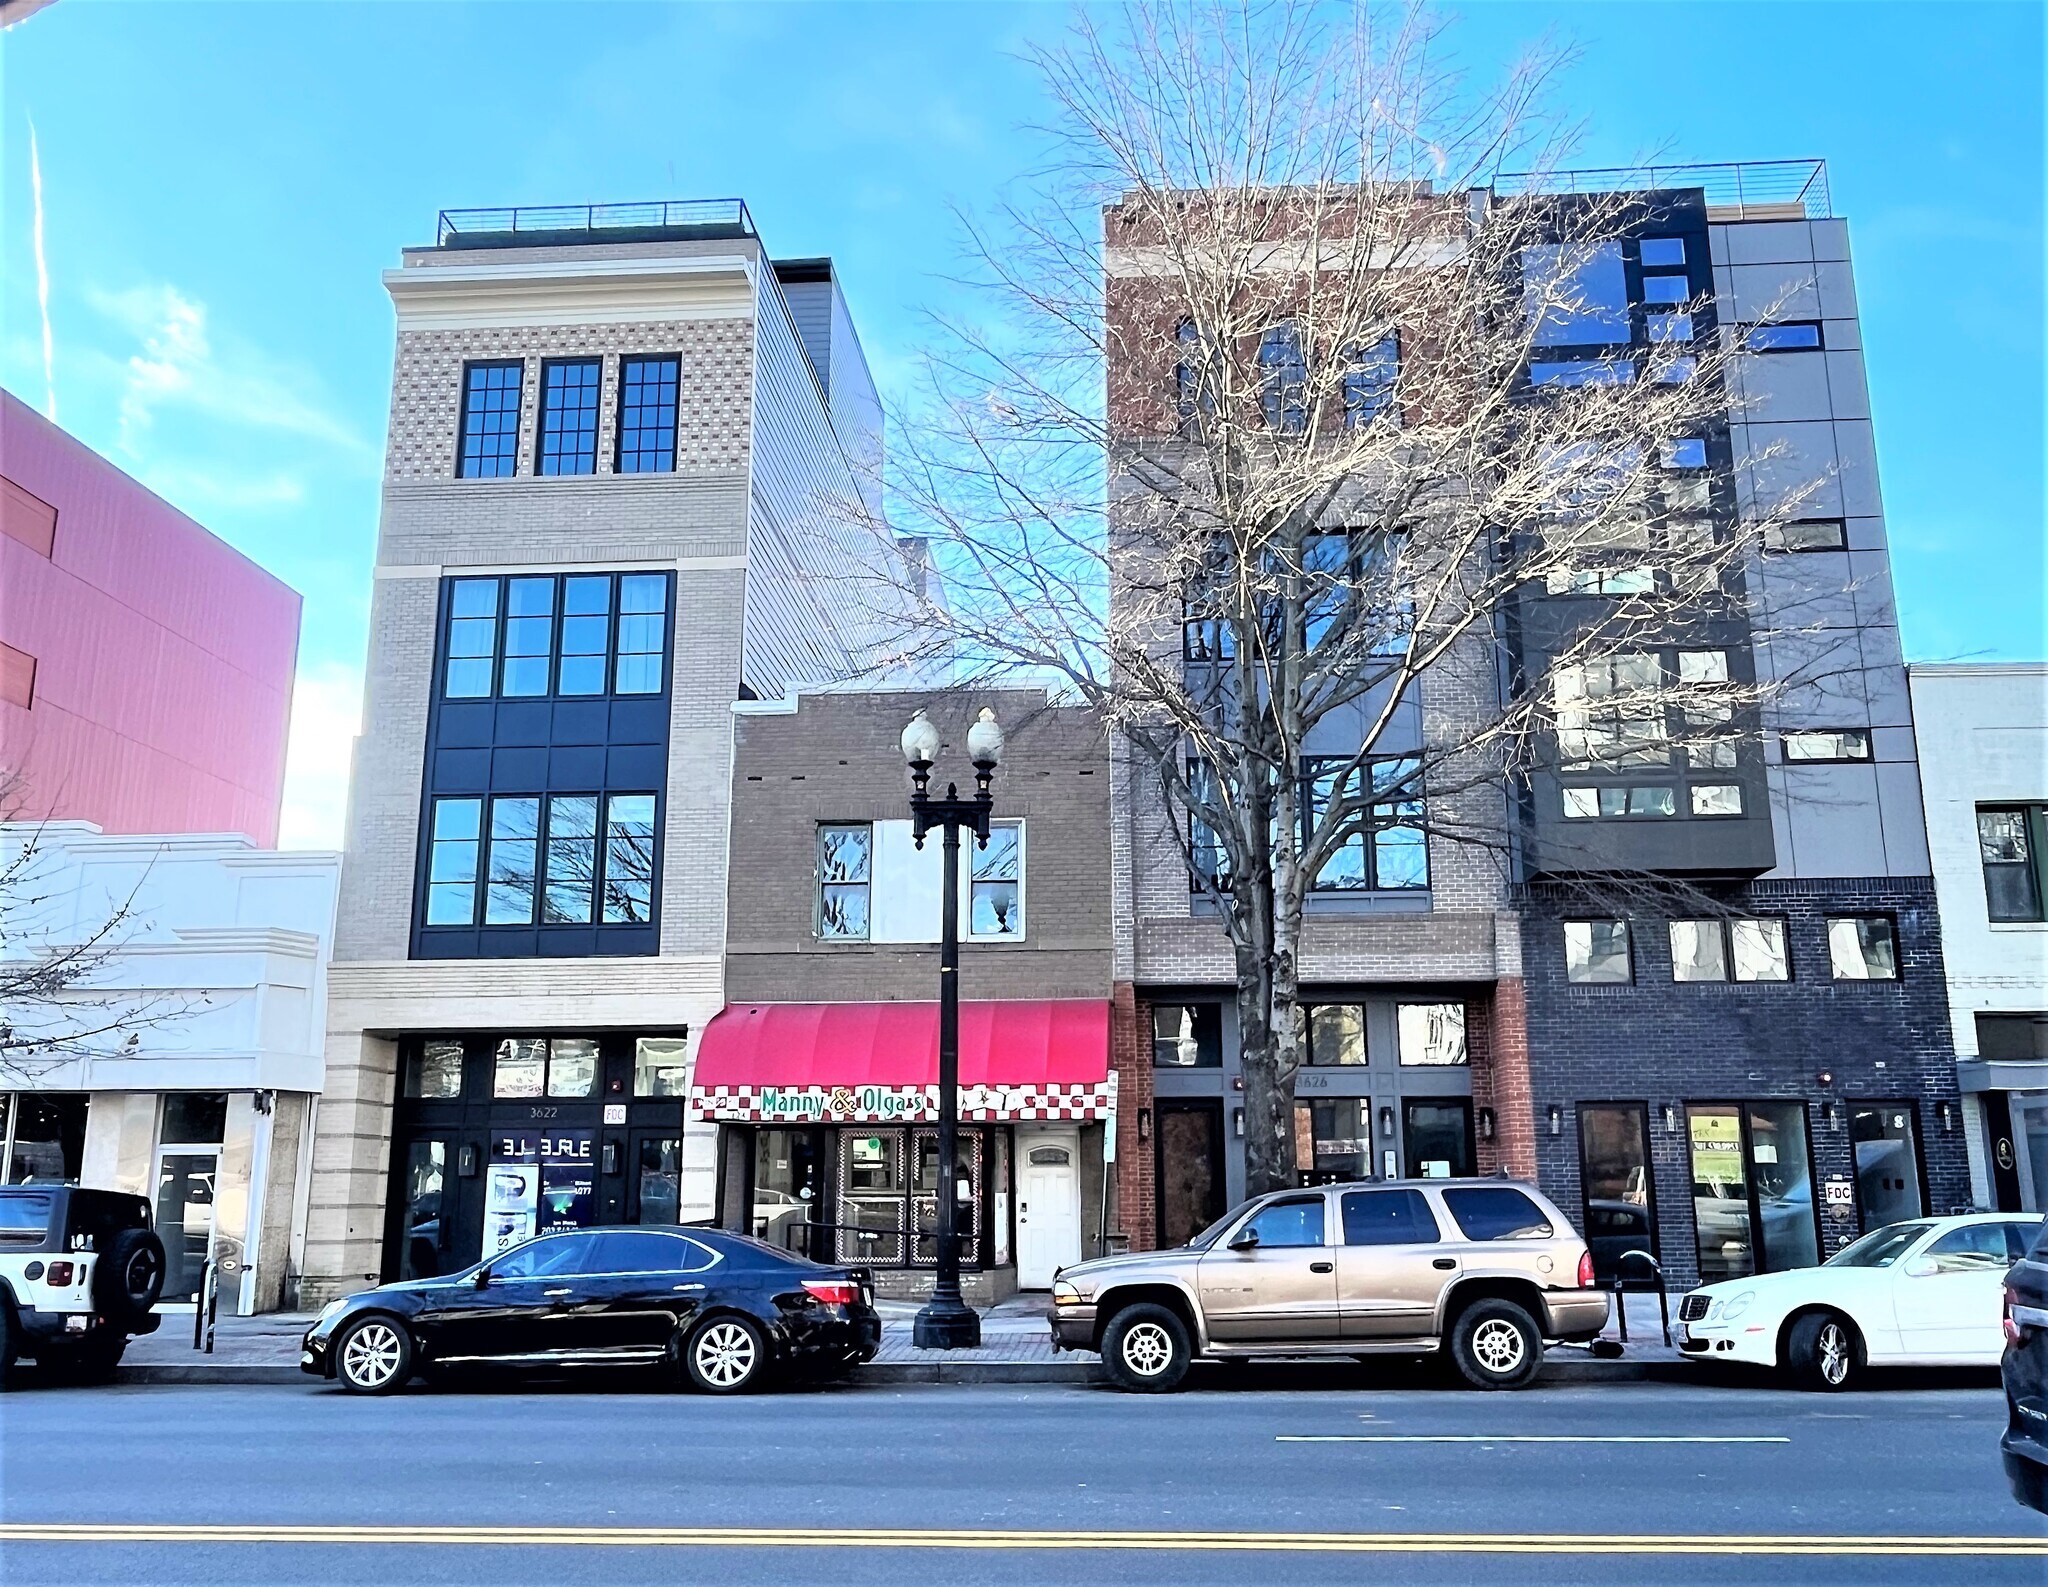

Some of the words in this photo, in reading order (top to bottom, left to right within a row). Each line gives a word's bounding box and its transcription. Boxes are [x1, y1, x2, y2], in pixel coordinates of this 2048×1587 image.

[762, 1088, 824, 1116] Manny
[829, 1088, 857, 1114] &
[530, 1107, 558, 1118] 3622
[606, 1109, 624, 1120] FDC
[1827, 1187, 1851, 1199] FDC
